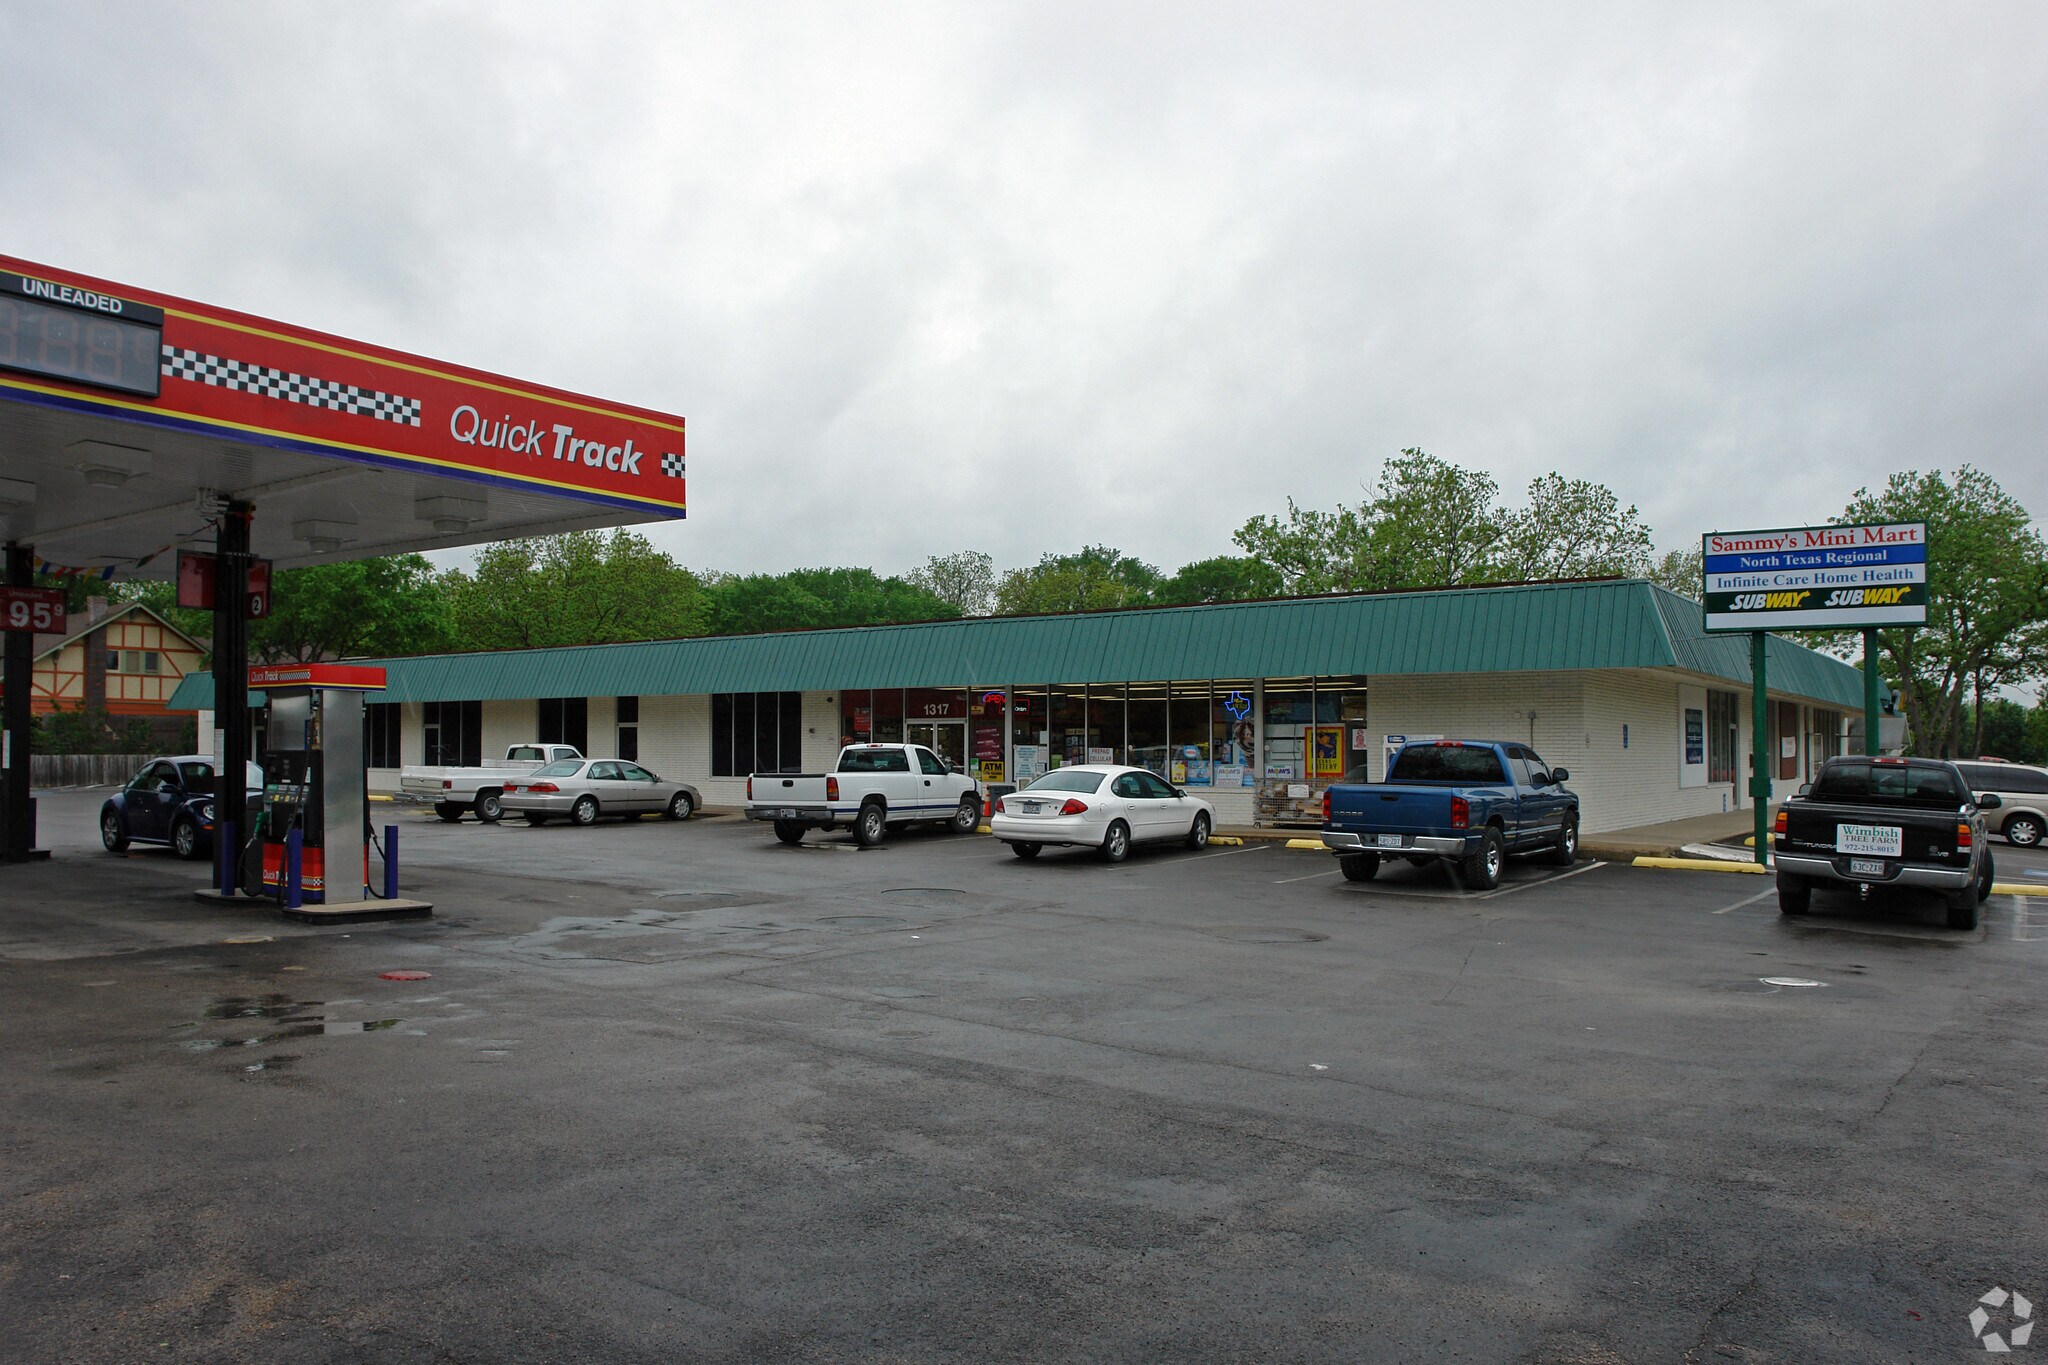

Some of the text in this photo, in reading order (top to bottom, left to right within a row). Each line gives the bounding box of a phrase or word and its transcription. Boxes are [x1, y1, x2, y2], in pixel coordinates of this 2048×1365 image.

[22, 277, 122, 313] UNLEADED
[450, 405, 643, 476] Quick Track
[1711, 526, 1918, 552] Sammy's Mini Mart
[1740, 550, 1887, 568] North Texas Regional
[1717, 568, 1914, 588] Infinite Care Home Health
[1729, 586, 1911, 611] SUBWAY SUBWAY
[923, 703, 949, 715] 1317
[984, 763, 1002, 771] ATM
[1842, 825, 1898, 838] Wimbish
[1844, 835, 1898, 844] TREE FARM
[1844, 844, 1895, 853] 972-215-8015
